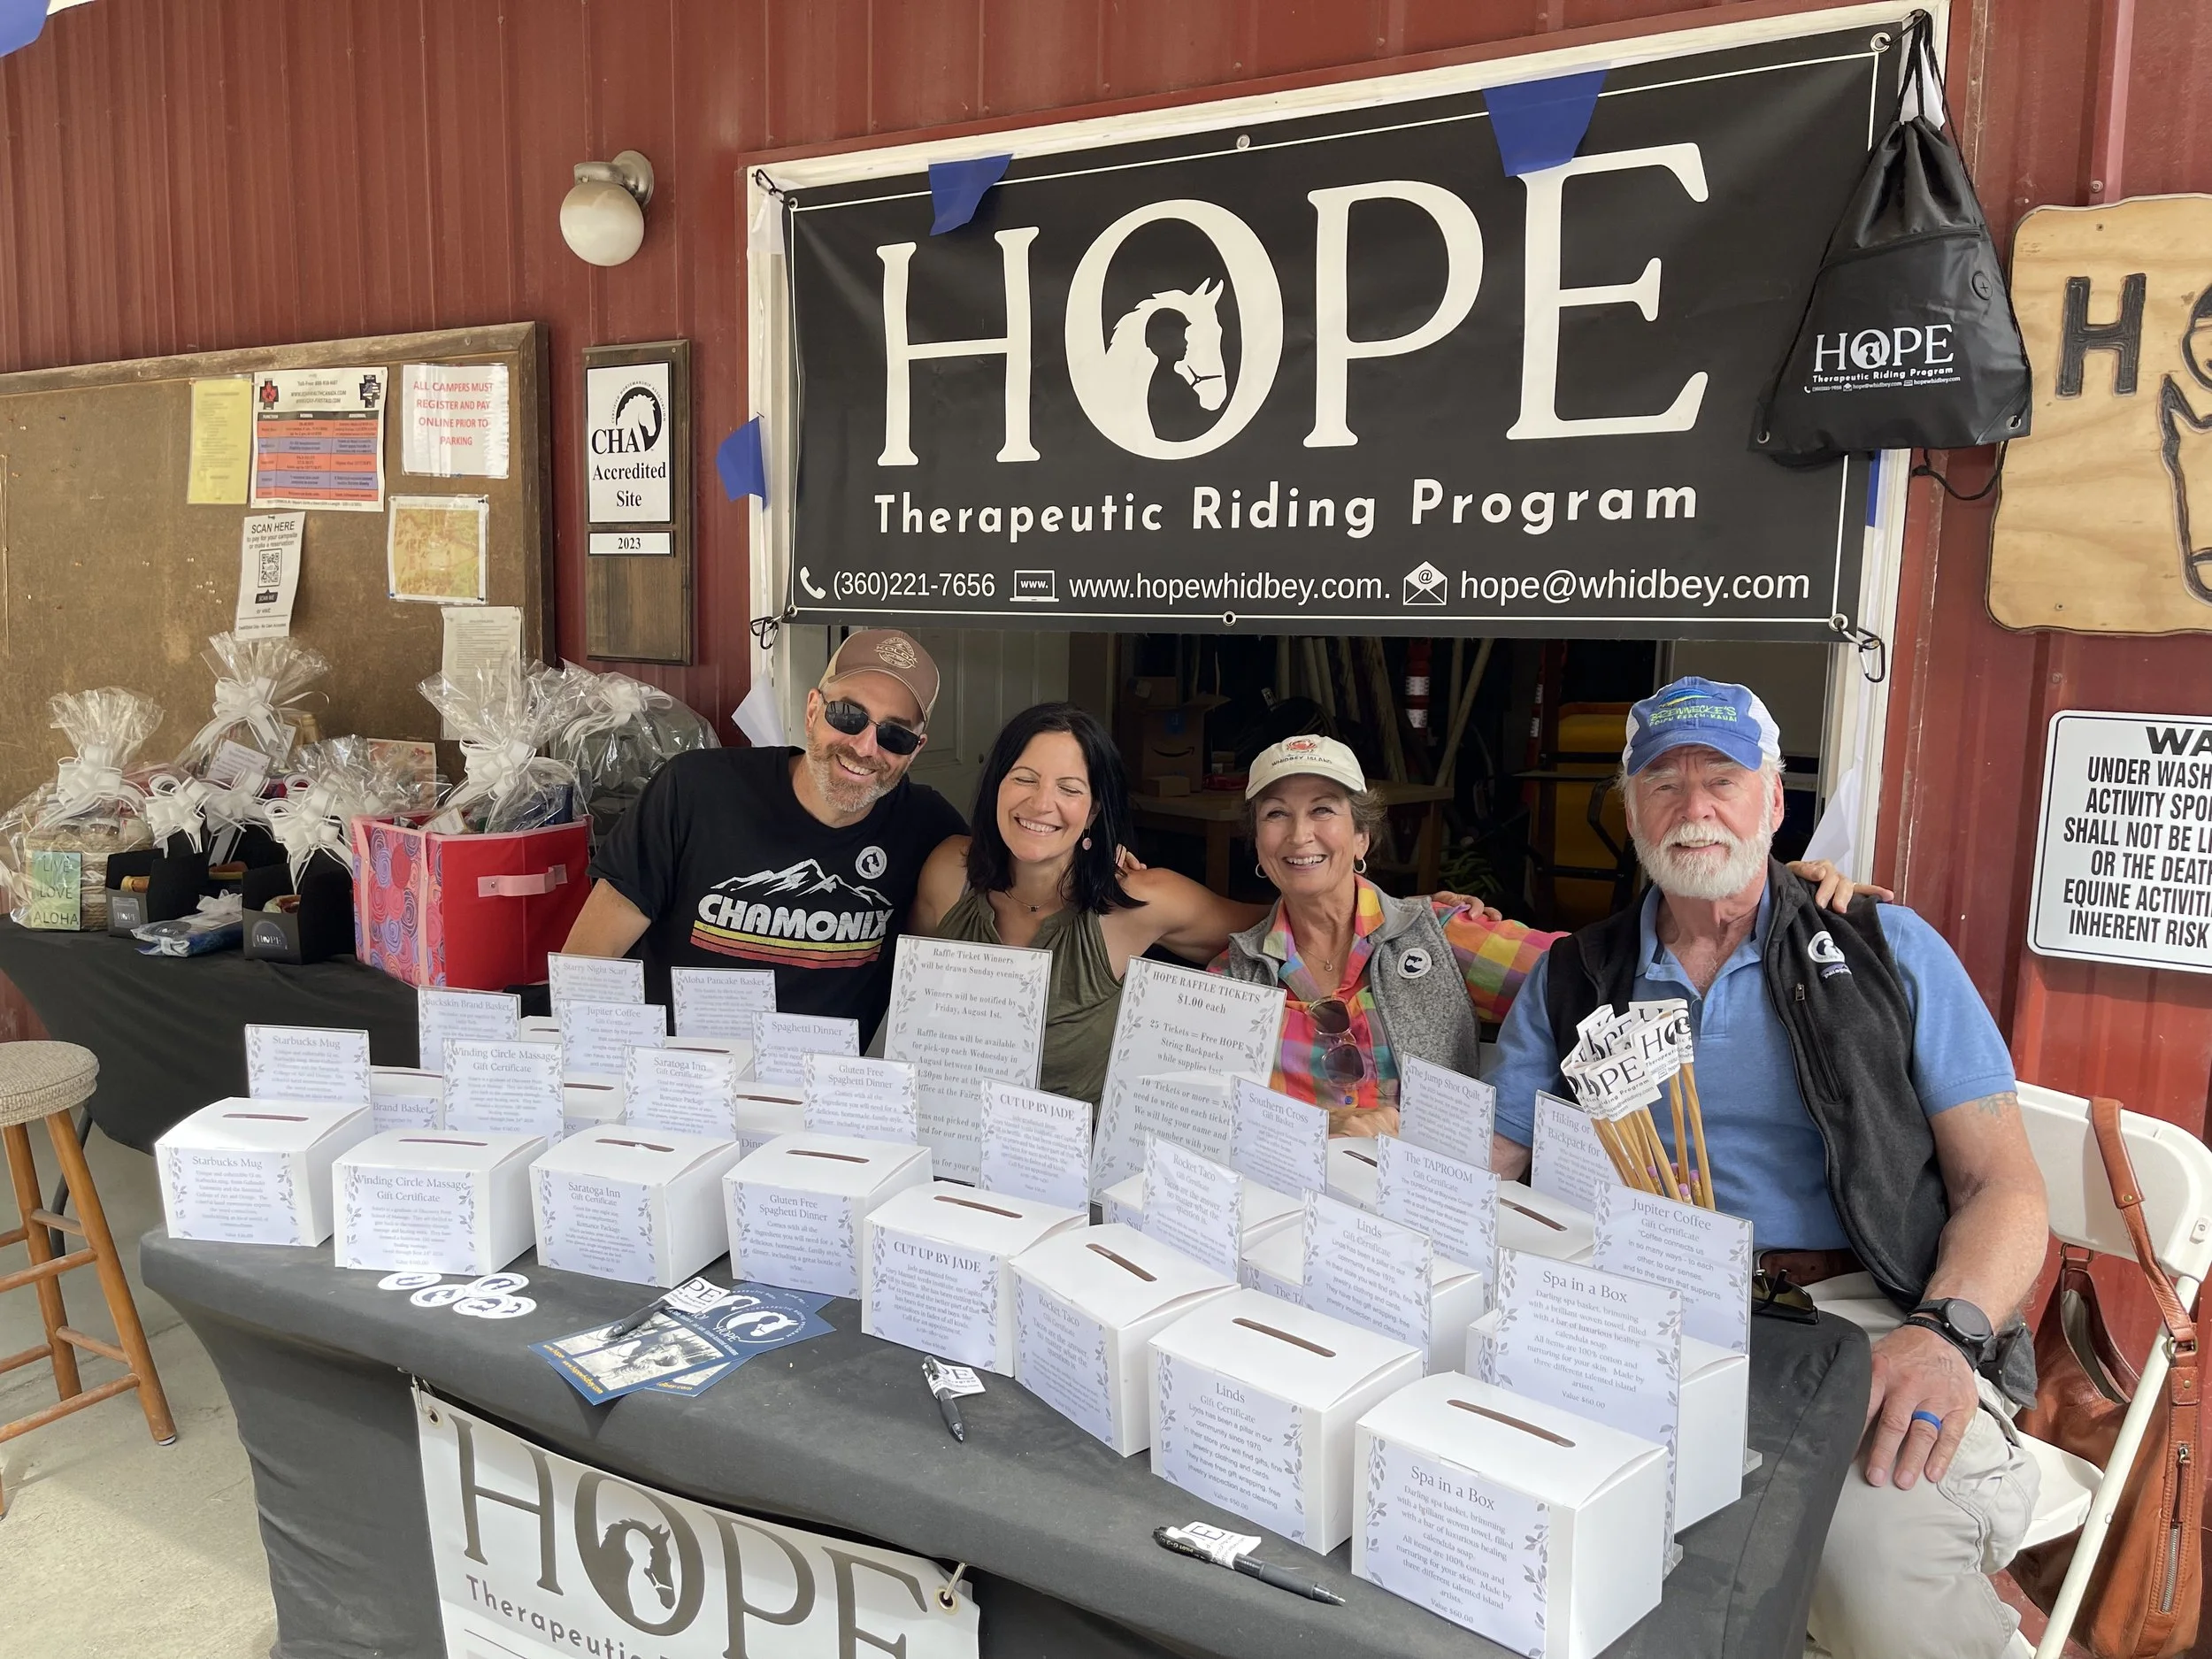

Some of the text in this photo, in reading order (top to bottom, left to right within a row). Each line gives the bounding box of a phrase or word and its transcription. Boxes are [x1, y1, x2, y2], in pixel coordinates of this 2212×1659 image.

[875, 142, 1709, 467] HOPE
[1814, 324, 1955, 372] HOPE
[1813, 367, 1954, 383] Therapeutic Riding Program
[413, 380, 494, 392] ALL CAMPERS MUST
[417, 399, 491, 410] REGISTER AND PAY
[419, 417, 488, 428] ONLINE PRIOR TO
[440, 436, 472, 446] PARKING
[591, 427, 641, 455] CHA
[593, 462, 666, 480] Accredited
[616, 490, 642, 507] Site
[873, 478, 1697, 543] Therapeutic Riding Program
[251, 520, 296, 534] SCAN HERE
[618, 537, 641, 549] 2023
[833, 568, 1810, 607] (360)221-7656 www. www.hopewhidbey.com. hope@whidbey.com
[2087, 757, 2212, 790] UNDER WASH
[2085, 787, 2212, 822] ACTIVITY SPO
[2063, 817, 2119, 847] SHALL
[2125, 822, 2163, 849] NOT
[2168, 826, 2193, 854] BE
[43, 859, 71, 873] LIVE
[2091, 850, 2116, 877] OR
[2123, 852, 2156, 880] THE
[40, 887, 73, 900] LOVE
[2063, 879, 2131, 910] EQUINE
[33, 910, 80, 926] ALOHA
[698, 894, 895, 941] CHAMONIX
[2069, 910, 2210, 949] INHERENT RISK
[933, 948, 1015, 964] Raffle Ticket Winners
[740, 977, 765, 986] Basket
[945, 964, 967, 973] drawn
[969, 966, 995, 978] Sunday
[996, 971, 1026, 981] evening.
[924, 987, 1018, 1008] Winners will be notified by
[1153, 972, 1261, 1004] HOPE RAFFLE TICKETS
[425, 998, 510, 1010] Buckskin Brand Basket
[587, 1006, 641, 1018] Jupiter Coffee
[935, 1002, 1002, 1019] Friday, August 1st.
[1177, 993, 1226, 1014] $1.00 each
[772, 1021, 843, 1036] Spaghetti Dinner
[1150, 1019, 1160, 1029] 25
[1163, 1022, 1189, 1037] Tickets
[1201, 1033, 1217, 1044] Free
[1219, 1037, 1244, 1050] HOPE
[273, 1035, 341, 1050] Starbucks Mug
[1161, 1037, 1225, 1061] String Backpacks
[452, 1047, 557, 1063] Winding Circle Massage
[654, 1056, 707, 1071] Saratoga Inn
[1410, 1064, 1480, 1101] The Jump Shot Quilt
[1000, 1094, 1075, 1120] CUT UP BY JADE
[192, 1156, 263, 1171] Starbucks Mug
[1404, 1150, 1473, 1184] The TAPROOM
[355, 1174, 467, 1192] Winding Circle Massage
[568, 1181, 621, 1198] Saratoga Inn
[376, 1190, 441, 1202] Gift Certificate
[770, 1194, 818, 1209] Gluten Free
[759, 1203, 828, 1221] Spaghetti Dinner
[1632, 1197, 1712, 1231] Jupiter Coffee
[1356, 1217, 1382, 1239] Linds
[1641, 1217, 1700, 1241] Gift Certificate
[894, 1240, 981, 1272] CUT UP BY JADE
[1542, 1270, 1628, 1303] Spa in a Box
[1037, 1293, 1080, 1327] Rocket Taco
[1216, 1382, 1245, 1403] Linds
[1410, 1465, 1495, 1511] Spa in a Box
[465, 1573, 650, 1659] Therapeuti
